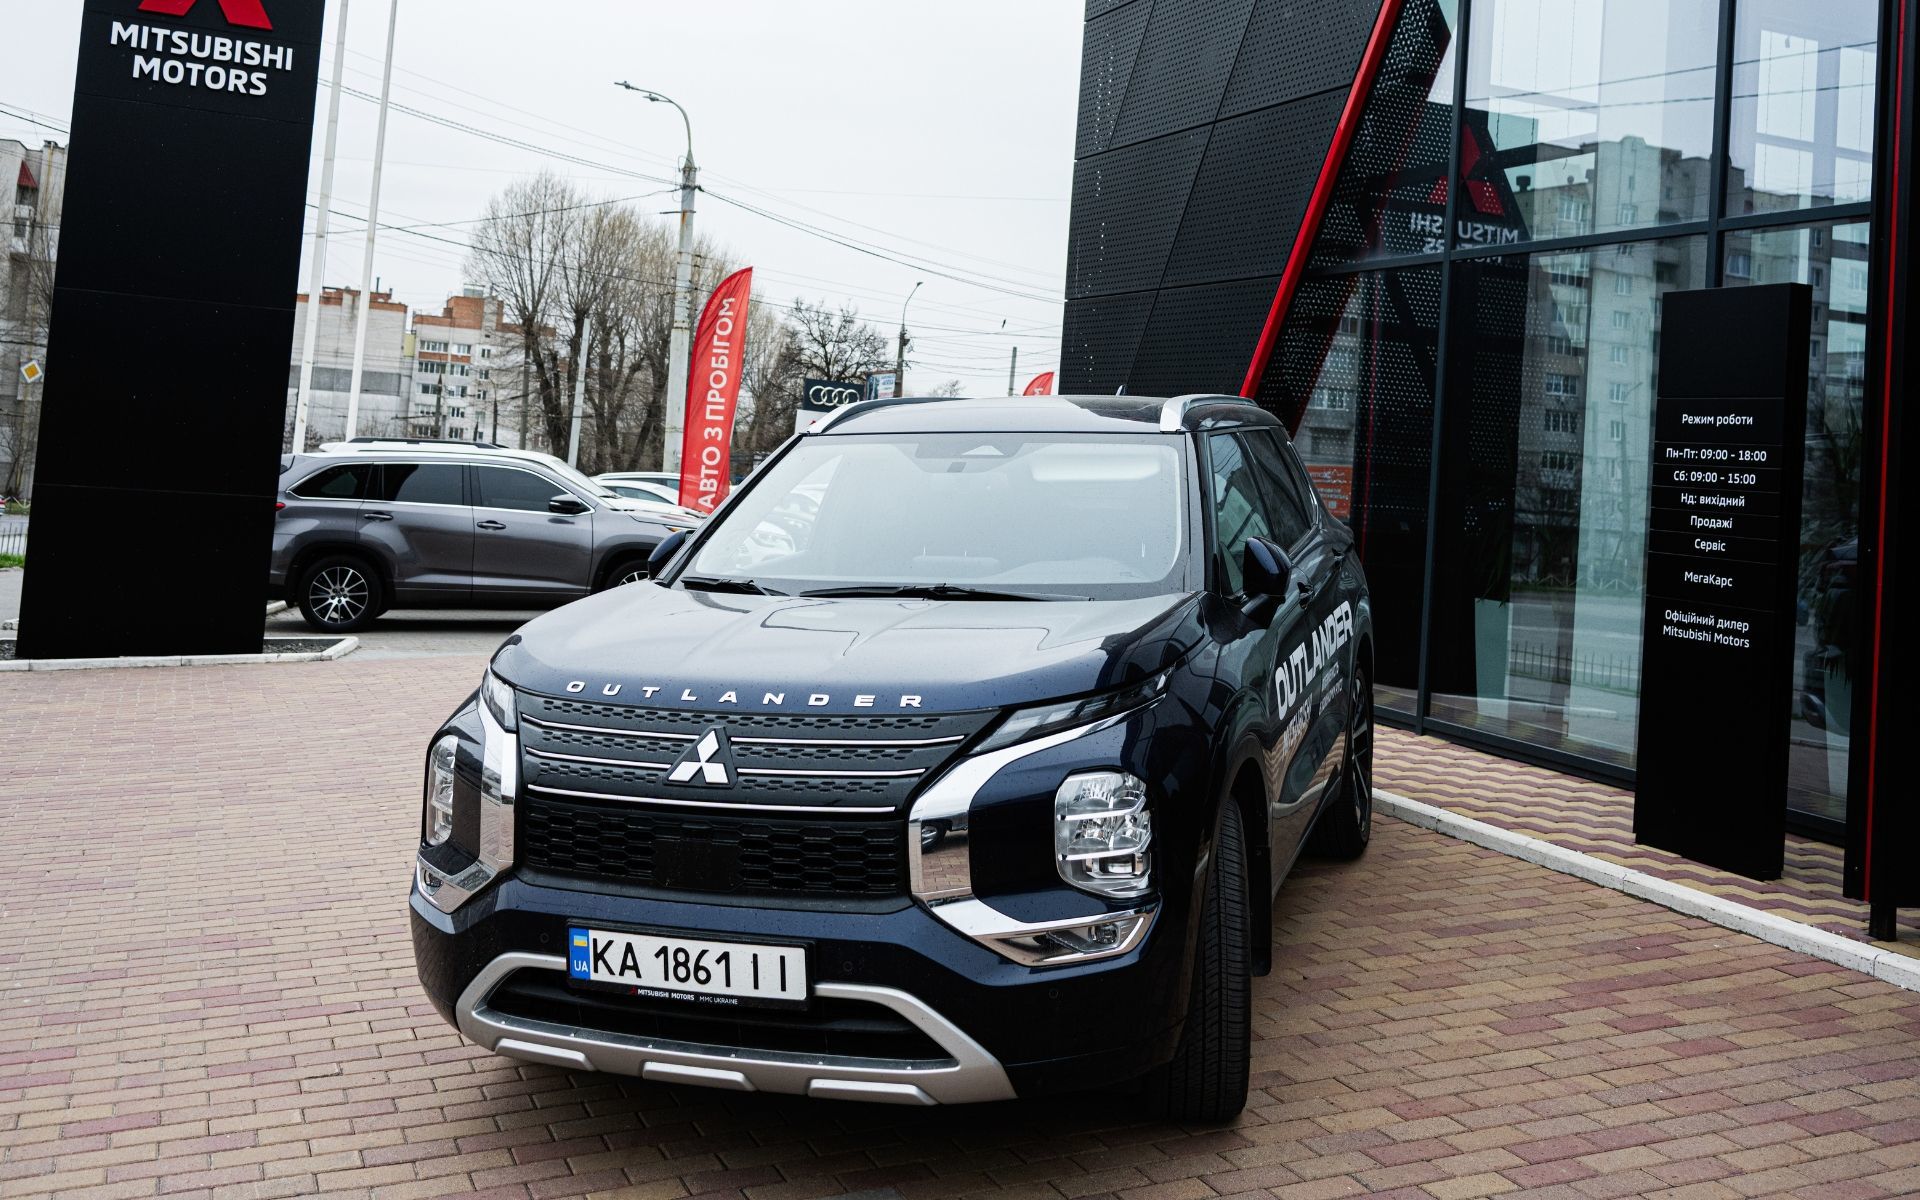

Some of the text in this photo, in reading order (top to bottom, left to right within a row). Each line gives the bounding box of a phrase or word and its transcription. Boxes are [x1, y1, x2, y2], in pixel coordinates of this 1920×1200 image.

[110, 21, 293, 71] MITSUBISHI
[132, 55, 267, 96] MOTORS
[706, 297, 735, 421] ПРОБІГОМ
[1682, 414, 1753, 427] Режим роботи
[1666, 448, 1698, 459] Пн-Пт:
[1700, 449, 1728, 460] 09:00
[1738, 450, 1767, 462] 18:00
[698, 446, 721, 509] АВТО
[1673, 471, 1688, 481] Сб:
[1690, 472, 1718, 483] 09:00
[1728, 473, 1756, 485] 15:00
[1681, 493, 1745, 507] Нд: вихідний
[1690, 516, 1733, 528] Продажі
[1694, 538, 1726, 552] Сервіс
[1684, 571, 1733, 588] МегаКарс
[1665, 609, 1749, 633] Офіційний дилер
[1663, 625, 1750, 648] Mitsubishi Motors
[1275, 600, 1353, 721] OUTLANDER
[566, 681, 923, 708] OUTLANDER
[573, 959, 589, 972] UA
[654, 945, 731, 988] 1861
[637, 988, 670, 998] MITSUBISHI
[671, 992, 695, 1001] MOTORS
[713, 997, 738, 1005] UKRAINE
